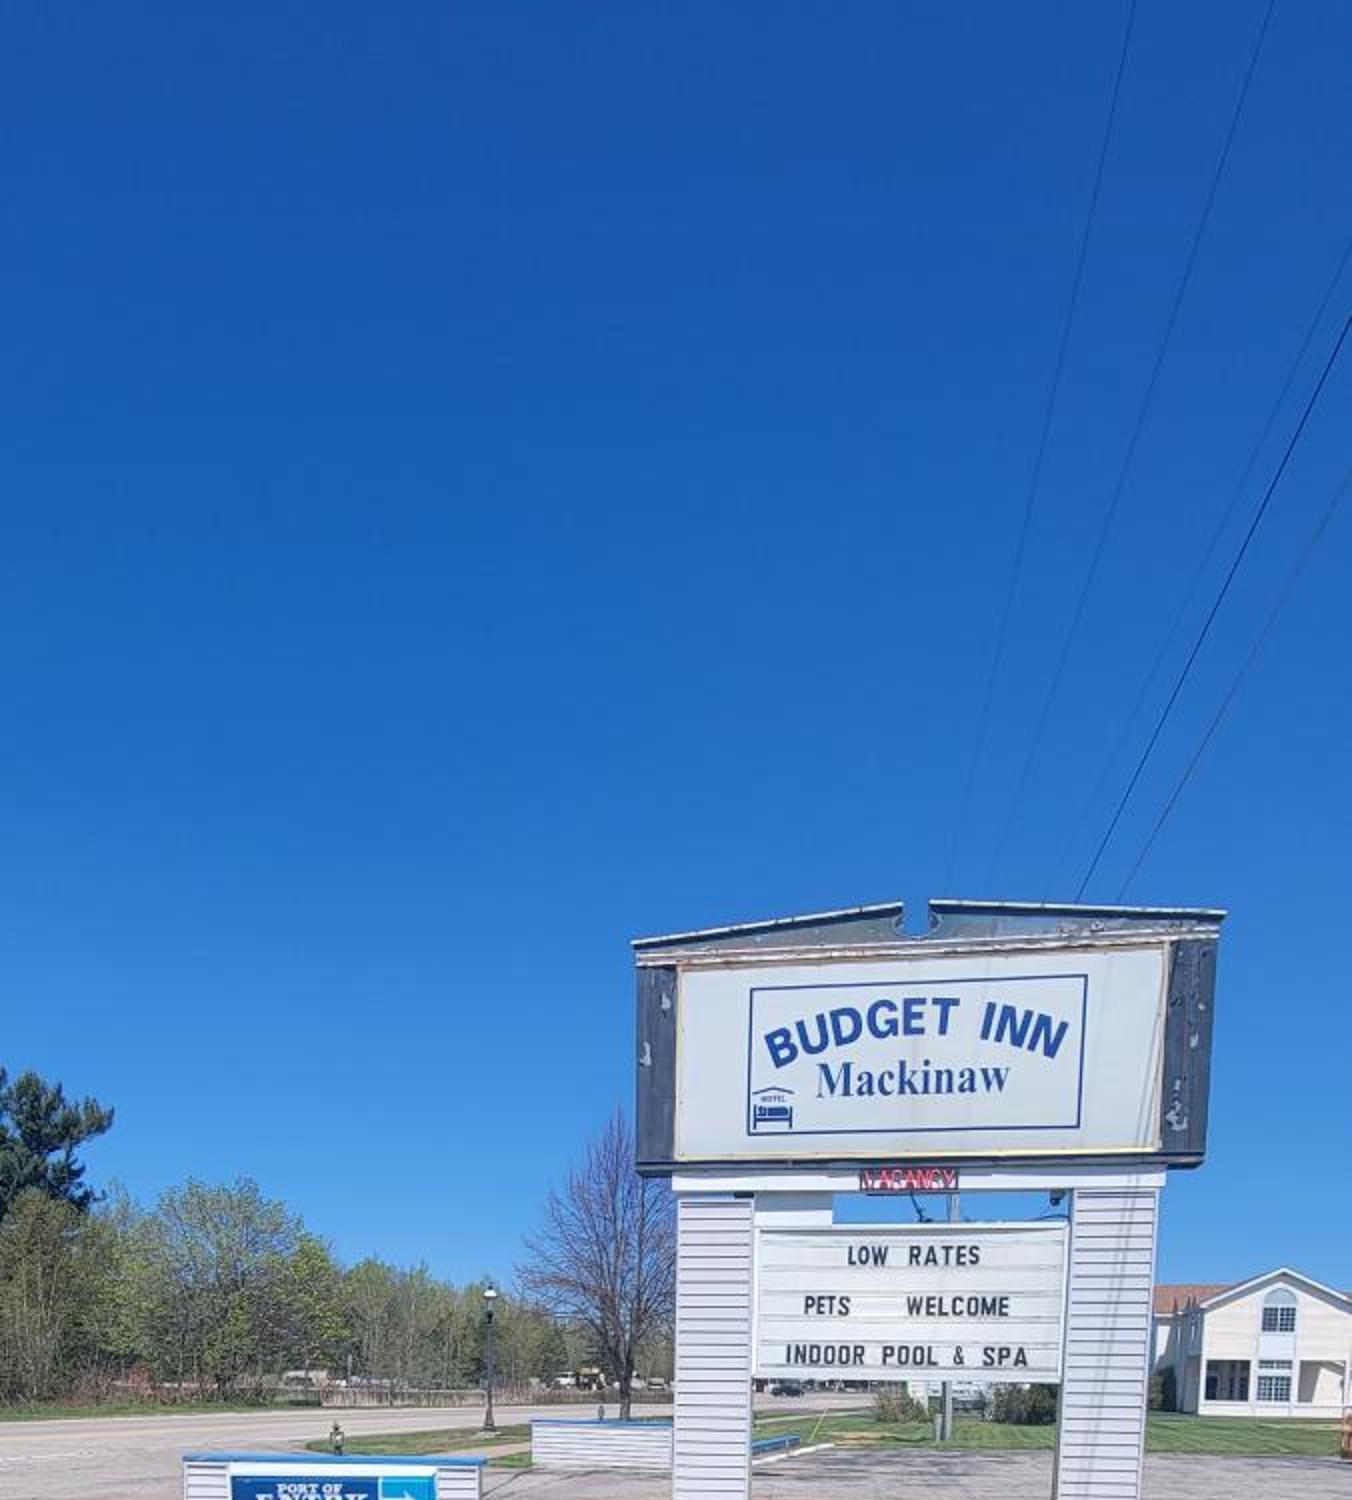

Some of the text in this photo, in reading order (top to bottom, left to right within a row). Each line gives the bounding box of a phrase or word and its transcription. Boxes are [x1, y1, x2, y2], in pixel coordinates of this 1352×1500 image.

[764, 998, 1068, 1068] BUDGET INN
[816, 1060, 1009, 1099] Mackinaw
[863, 1169, 955, 1190] VACANCY
[848, 1245, 980, 1265] LOW RATES
[804, 1296, 1009, 1316] PETS WELCOME
[786, 1344, 1027, 1367] INDOOR POOL & SPA
[276, 1483, 342, 1494] PORT OF
